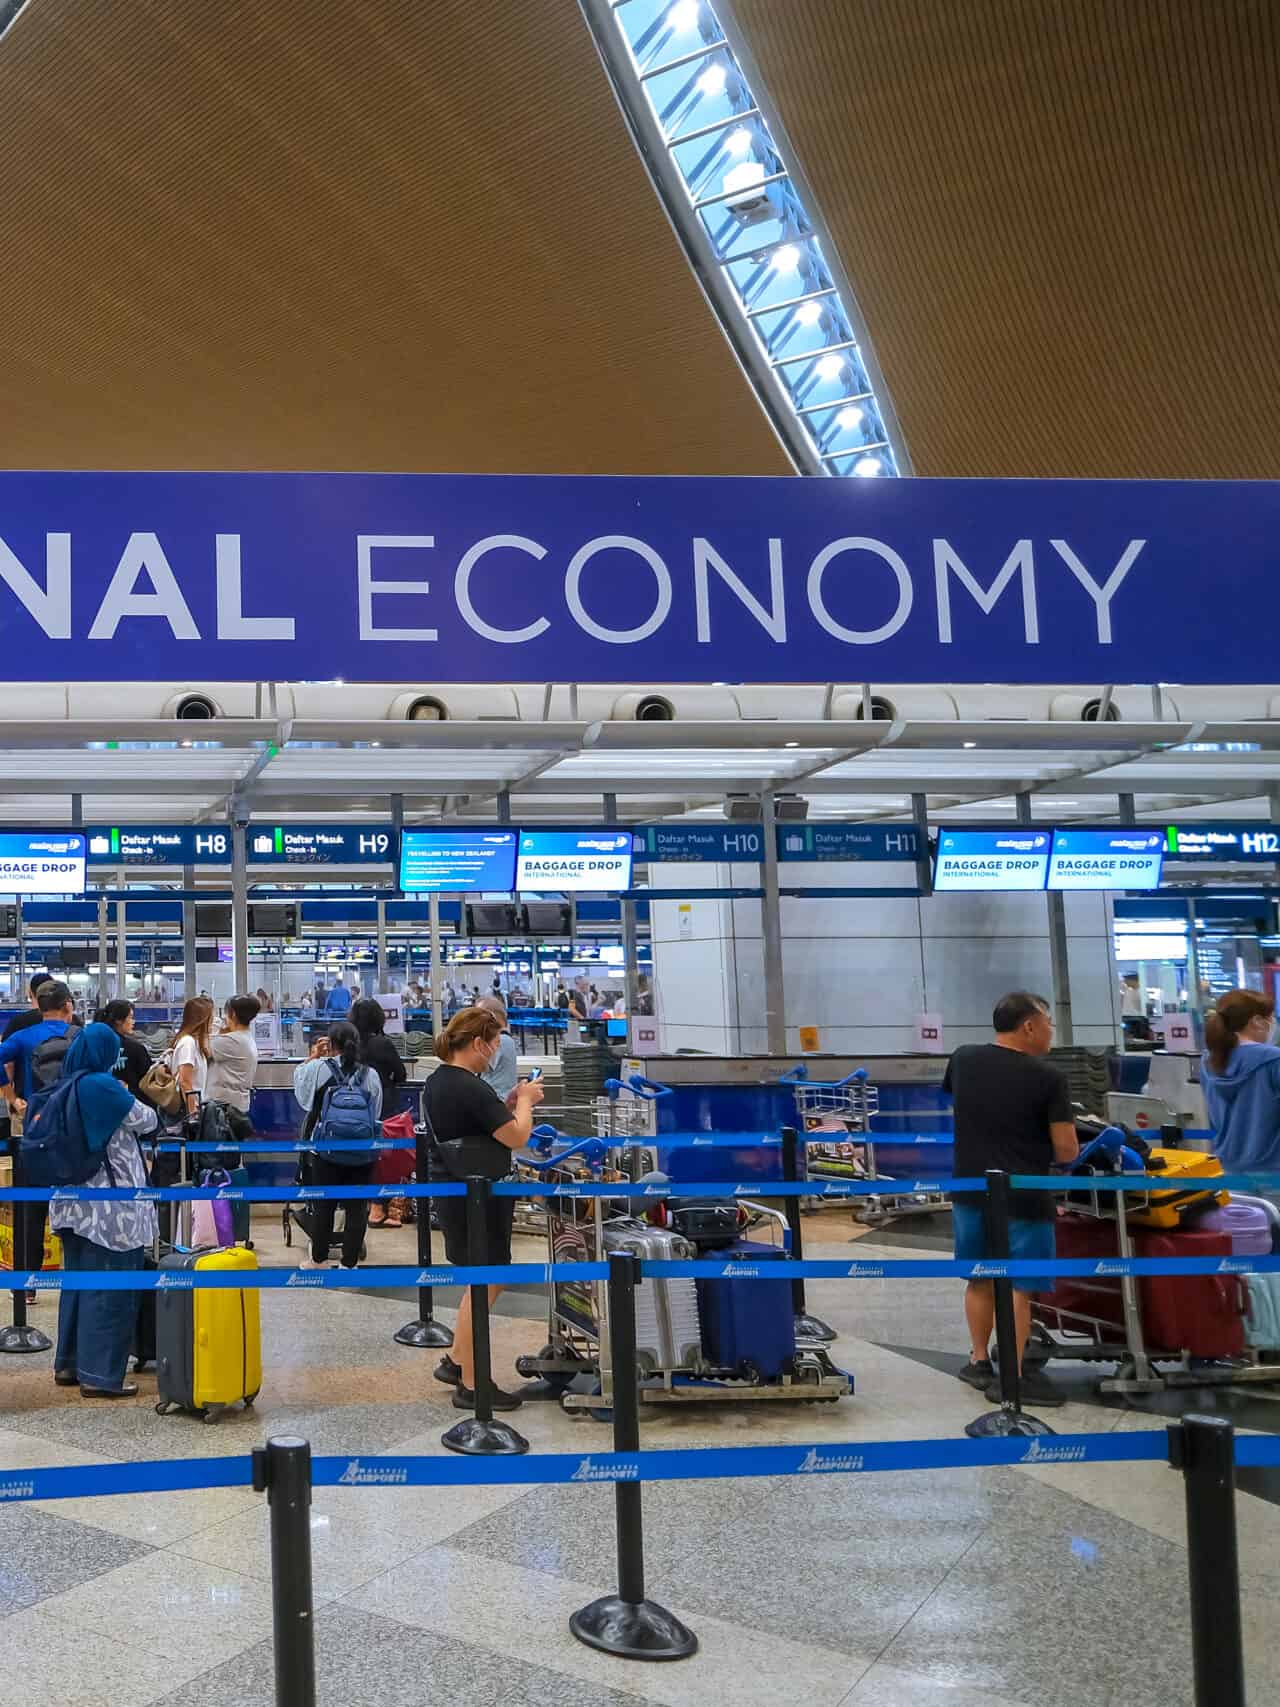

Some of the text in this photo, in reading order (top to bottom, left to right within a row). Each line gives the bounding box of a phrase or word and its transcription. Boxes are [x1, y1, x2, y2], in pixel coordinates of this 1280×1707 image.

[357, 533, 1147, 646] ECONOMY
[121, 835, 181, 845] Daftar Masuk
[284, 834, 344, 845] Daftar Masuk
[657, 834, 714, 843] Daftar Masuk
[723, 834, 759, 852] H10
[815, 834, 872, 843] Daftar Masuk
[885, 834, 917, 852] H11
[1242, 833, 1280, 852] H12
[196, 835, 226, 854] H8
[359, 835, 388, 854] H9
[42, 863, 77, 872] DROP
[525, 861, 622, 870] BAGGAGE DROP
[944, 861, 1040, 870] BAGGAGE DROP
[1056, 860, 1153, 869] BAGGAGE DROP
[1037, 1451, 1086, 1461] AIRPORTS
[815, 1461, 863, 1471] AIRPORTS
[356, 1473, 407, 1482] AIRPORTS
[588, 1469, 638, 1480] AIRPORTS
